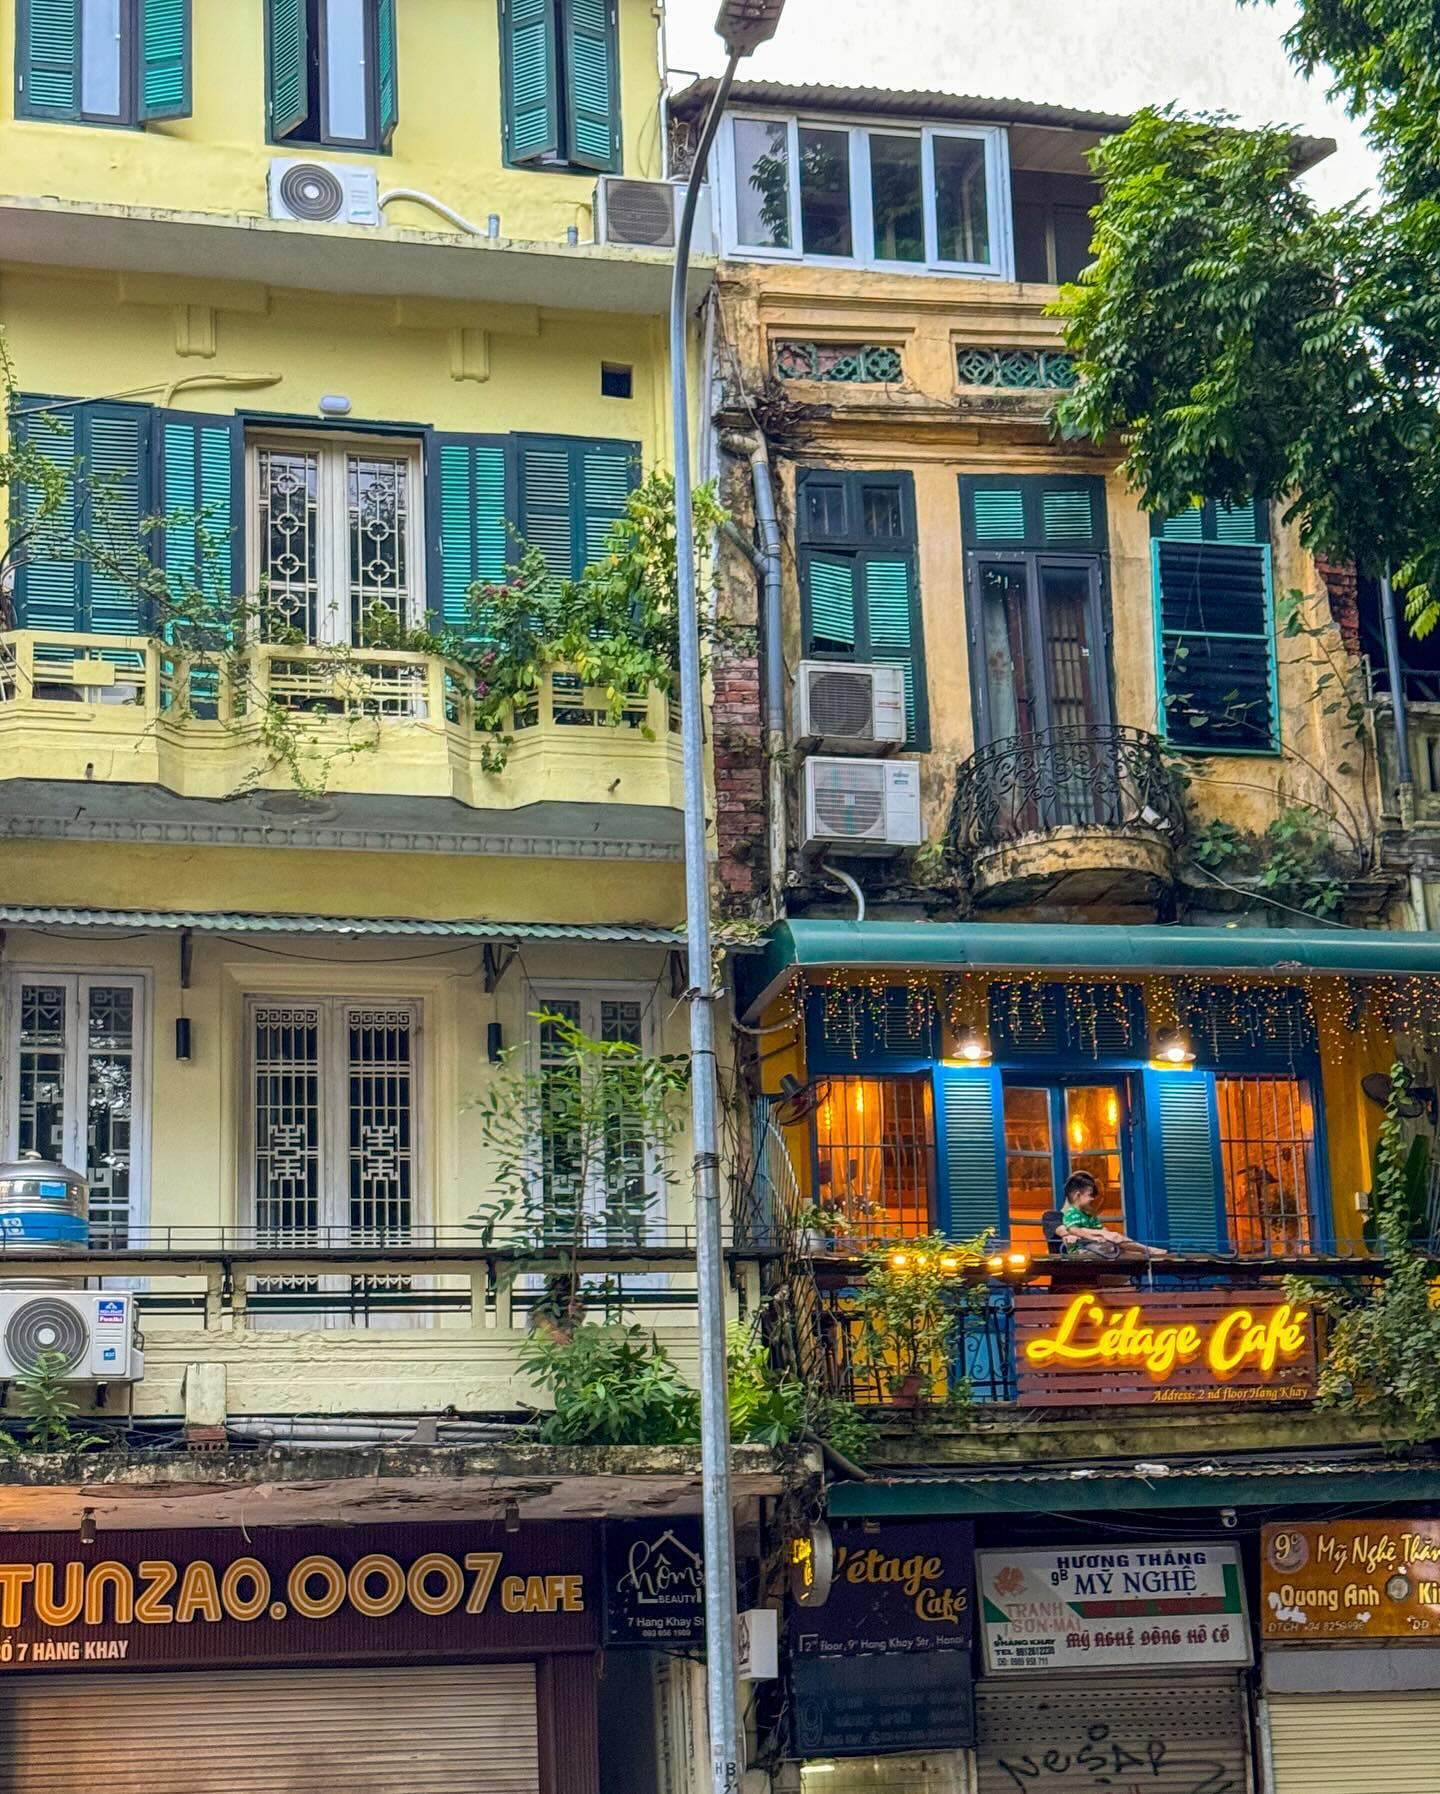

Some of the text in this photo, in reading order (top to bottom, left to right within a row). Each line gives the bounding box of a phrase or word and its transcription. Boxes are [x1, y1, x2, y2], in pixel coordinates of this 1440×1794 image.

[1025, 1294, 1309, 1373] L'étage Café
[1152, 1384, 1309, 1402] Address: 2 nd floor Hang Khay
[1057, 1554, 1130, 1568] HƯƠNG
[1317, 1534, 1349, 1574] Mỹ
[1352, 1535, 1397, 1573] Nghệ
[502, 1575, 584, 1613] CAFE
[658, 1595, 697, 1603] BEAUTY
[1280, 1585, 1339, 1611] Quang
[1344, 1583, 1380, 1607] Anh
[914, 1588, 967, 1624] Café
[1004, 1602, 1063, 1617] TRANH
[628, 1618, 635, 1627] 7
[637, 1617, 664, 1628] Hang
[666, 1616, 692, 1628] Khay
[17, 1642, 28, 1660] 7
[33, 1639, 81, 1661] HÀNG
[84, 1640, 129, 1659] KHAY
[861, 1636, 886, 1650] Hang
